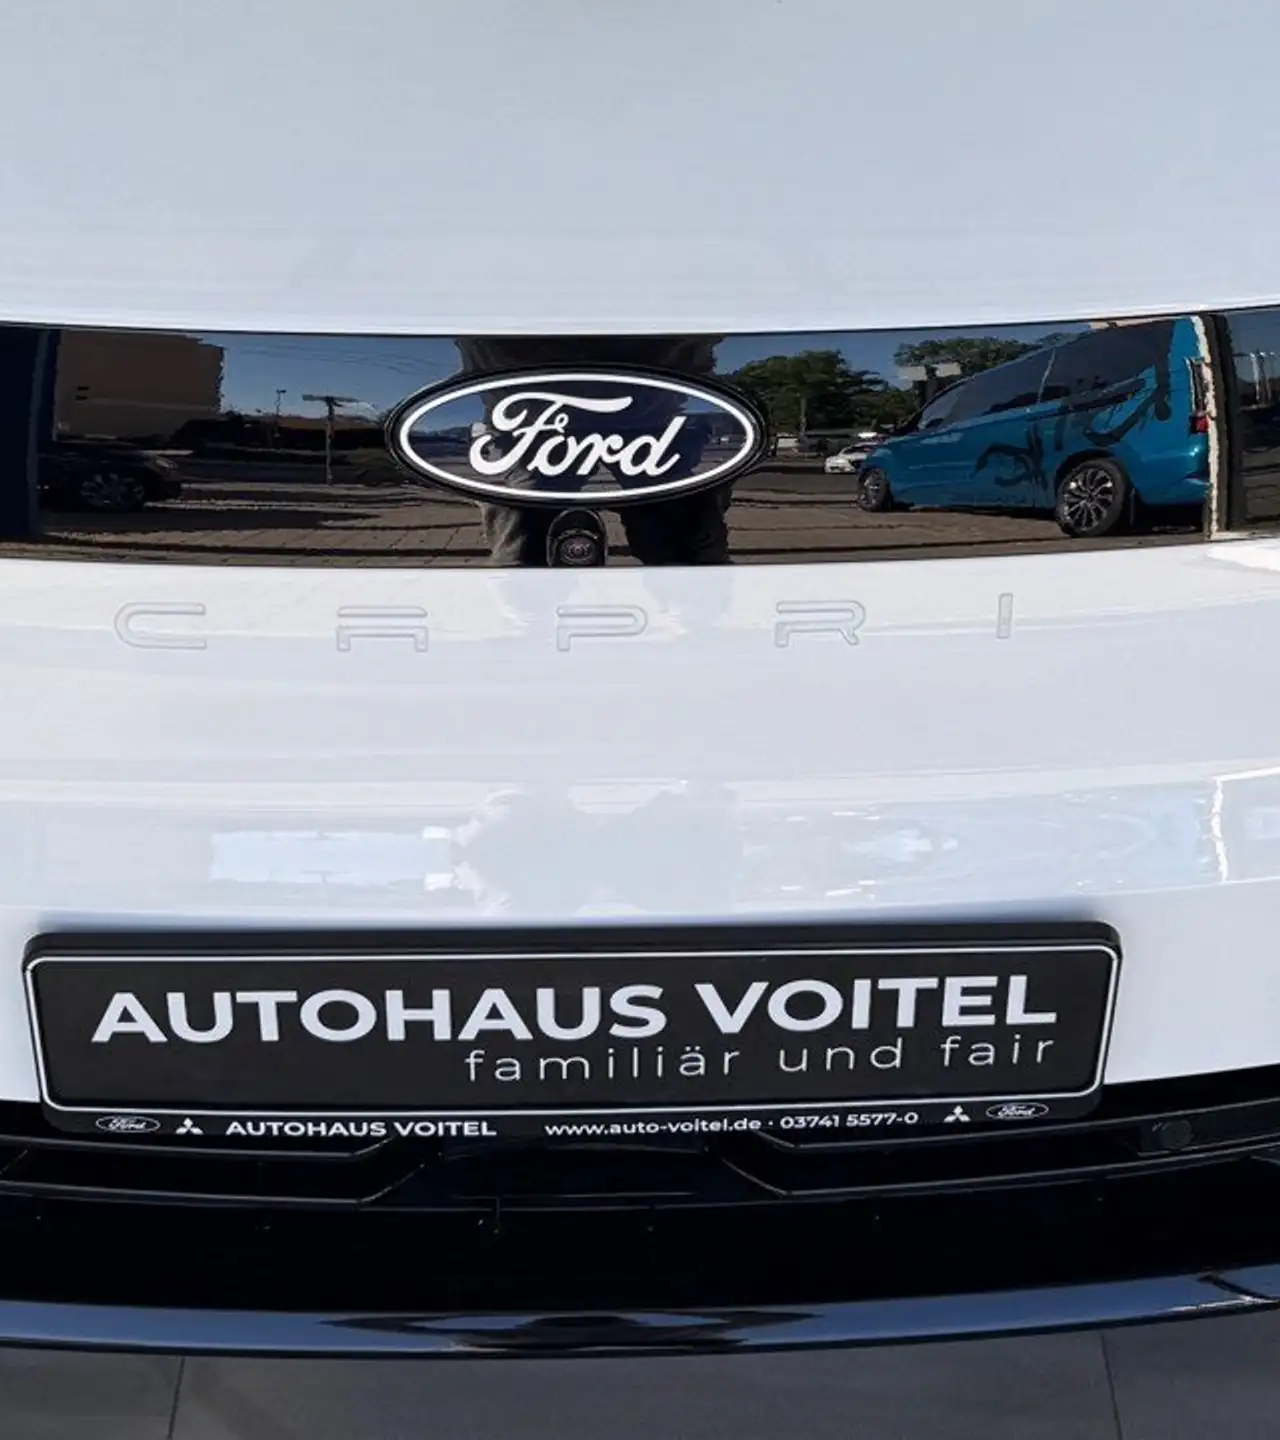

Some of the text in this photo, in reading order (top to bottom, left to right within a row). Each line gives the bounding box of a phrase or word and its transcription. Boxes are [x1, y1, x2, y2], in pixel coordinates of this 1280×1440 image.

[469, 391, 687, 476] Ford
[113, 592, 1014, 652] CAPRI
[91, 974, 1058, 1043] AUTOHAUS VOITEL
[465, 1034, 1054, 1081] familiär und fair
[225, 1121, 388, 1137] AUTOHAUS
[393, 1120, 498, 1137] VOITEL
[544, 1117, 762, 1136] www.auto-voitel.de
[779, 1114, 841, 1129] 03741
[846, 1111, 919, 1127] 5577-0
